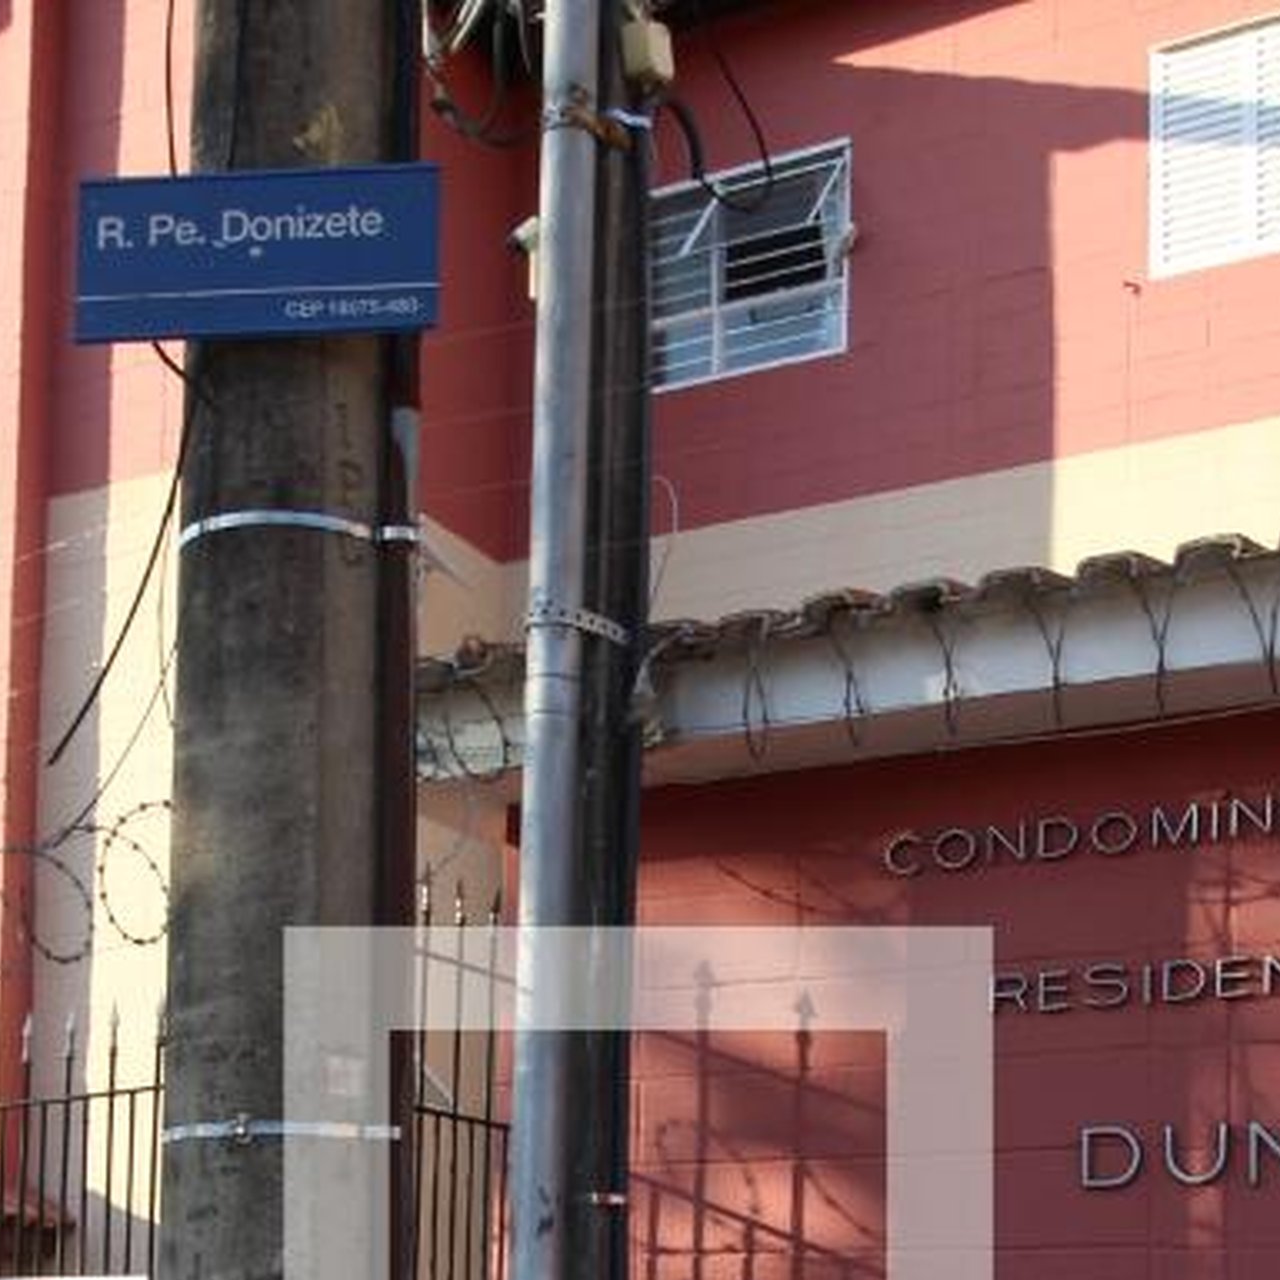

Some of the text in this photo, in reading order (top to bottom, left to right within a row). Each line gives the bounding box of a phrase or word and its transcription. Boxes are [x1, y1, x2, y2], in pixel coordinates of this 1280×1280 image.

[96, 205, 384, 249] R. Pe. Donizete
